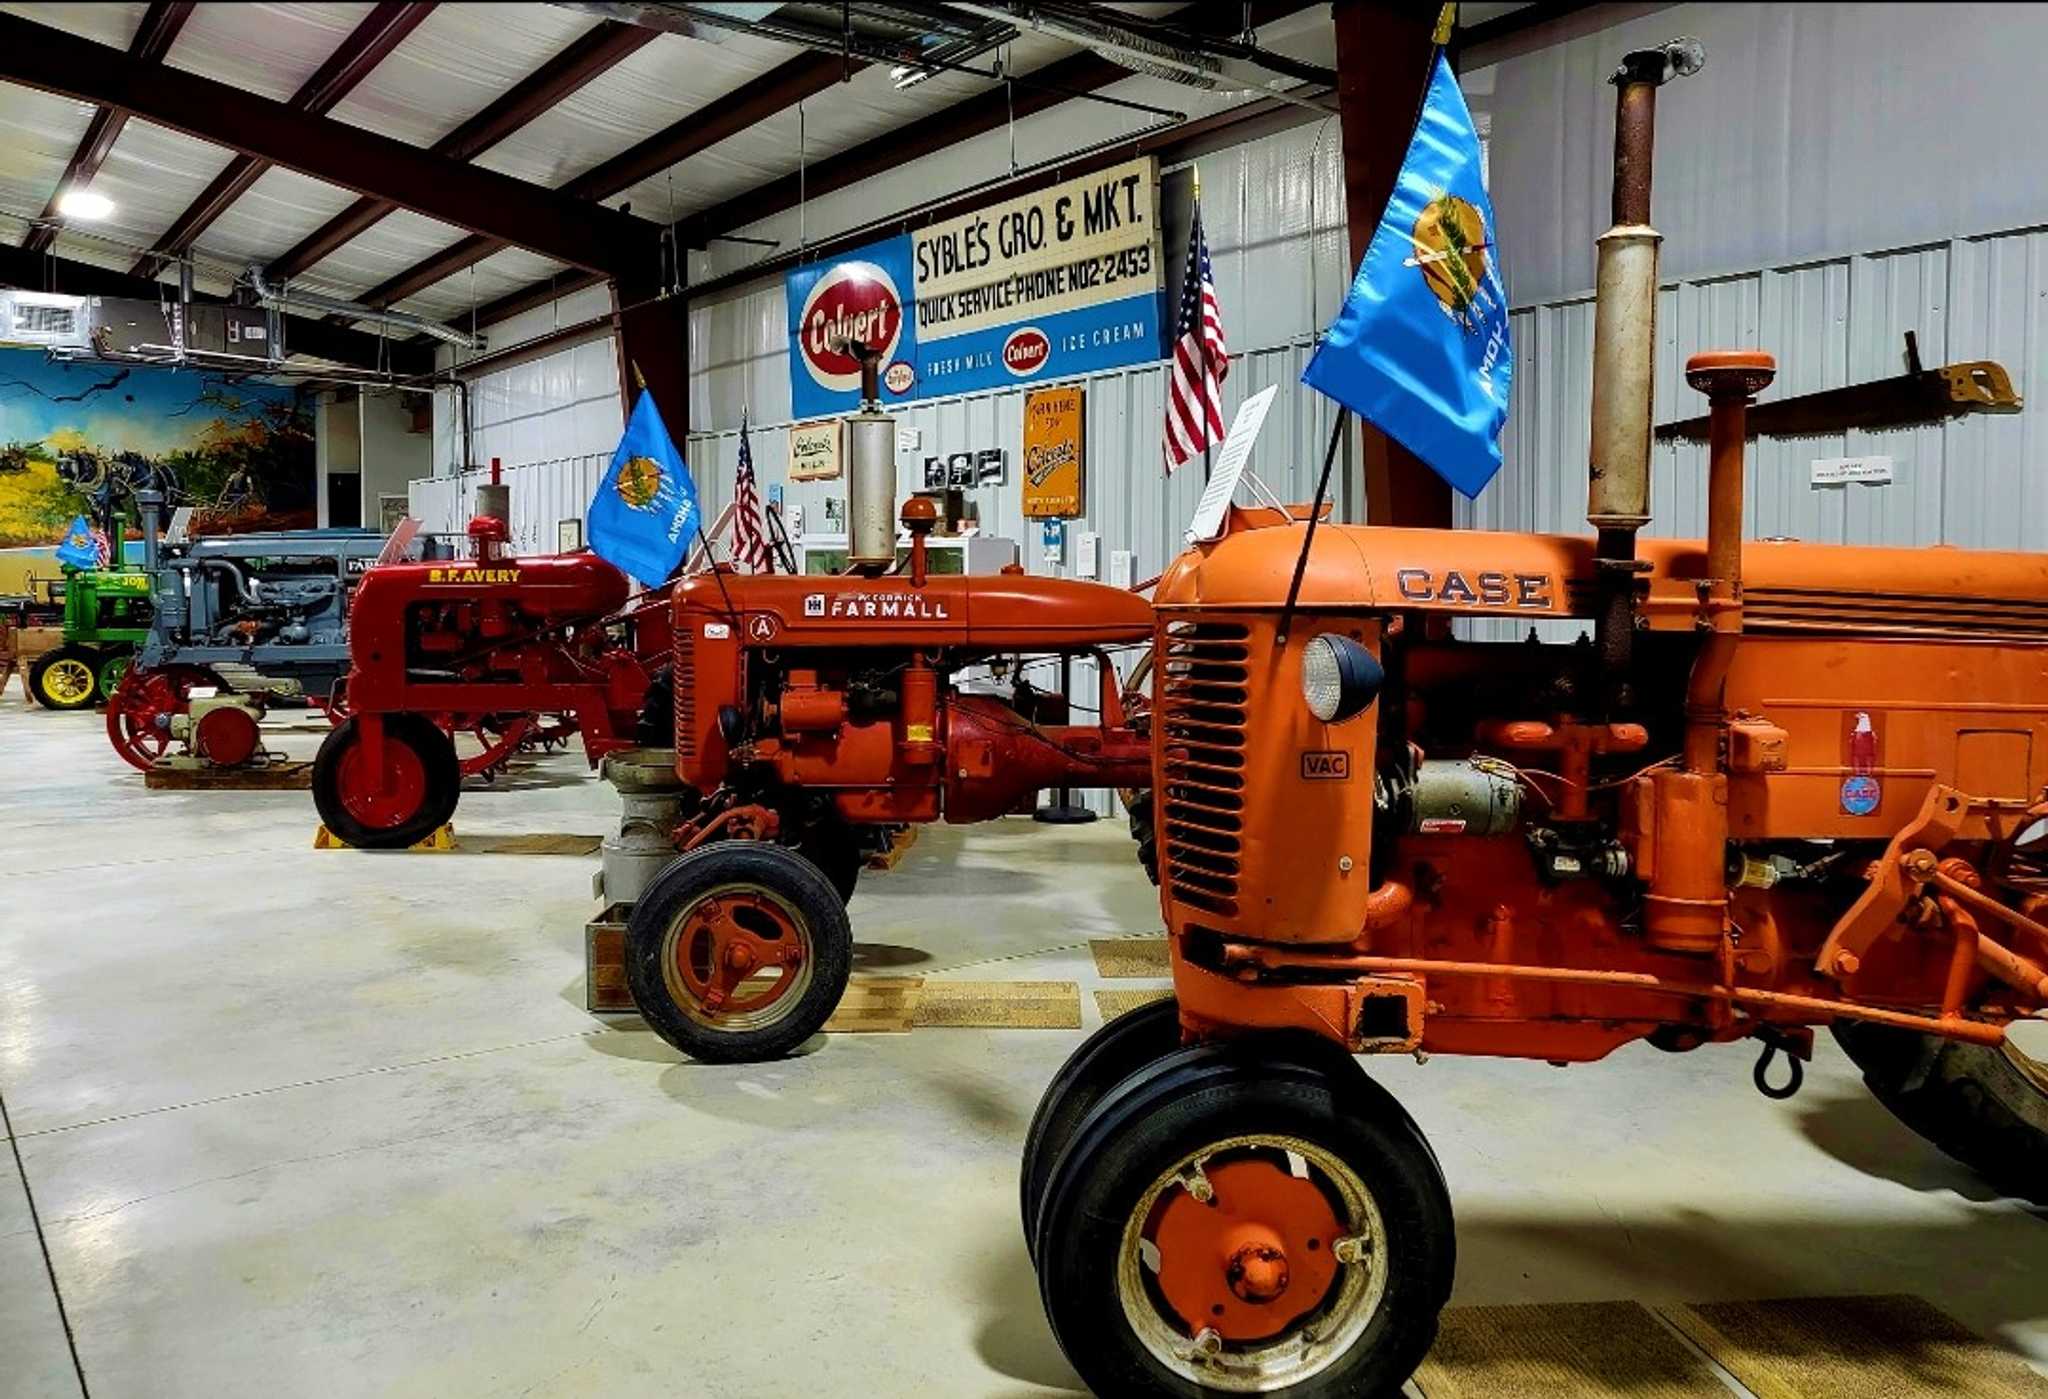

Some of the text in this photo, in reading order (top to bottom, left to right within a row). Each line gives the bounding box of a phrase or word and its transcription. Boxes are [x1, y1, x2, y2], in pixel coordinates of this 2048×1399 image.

[1055, 196, 1075, 242] &
[1062, 321, 1145, 353] ICE CREAM
[1397, 568, 1552, 608] CASE
[831, 601, 949, 618] FARMALL
[756, 619, 770, 636] A
[1305, 756, 1345, 774] VAC
